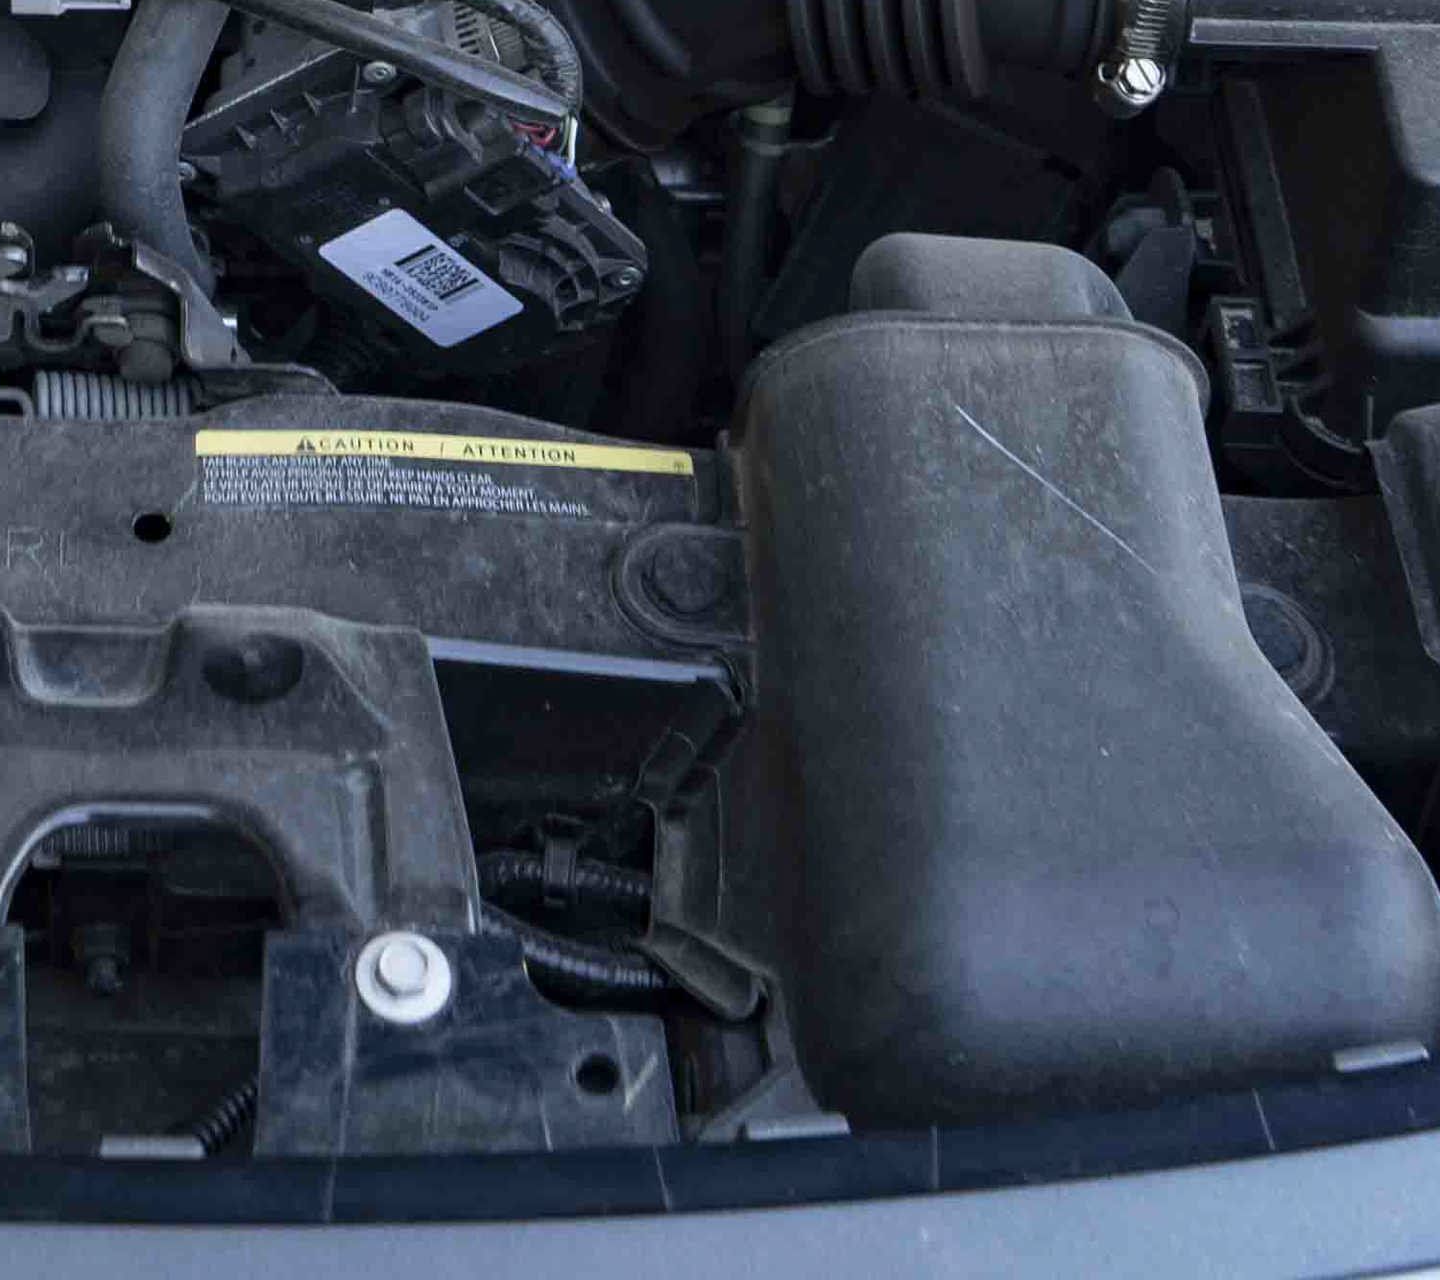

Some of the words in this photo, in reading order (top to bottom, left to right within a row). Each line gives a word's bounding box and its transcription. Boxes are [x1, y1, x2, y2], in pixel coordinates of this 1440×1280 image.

[319, 436, 415, 452] CAUTION
[462, 442, 576, 463] ATTENTION
[341, 457, 363, 468] ANY
[417, 470, 455, 483] HANDS
